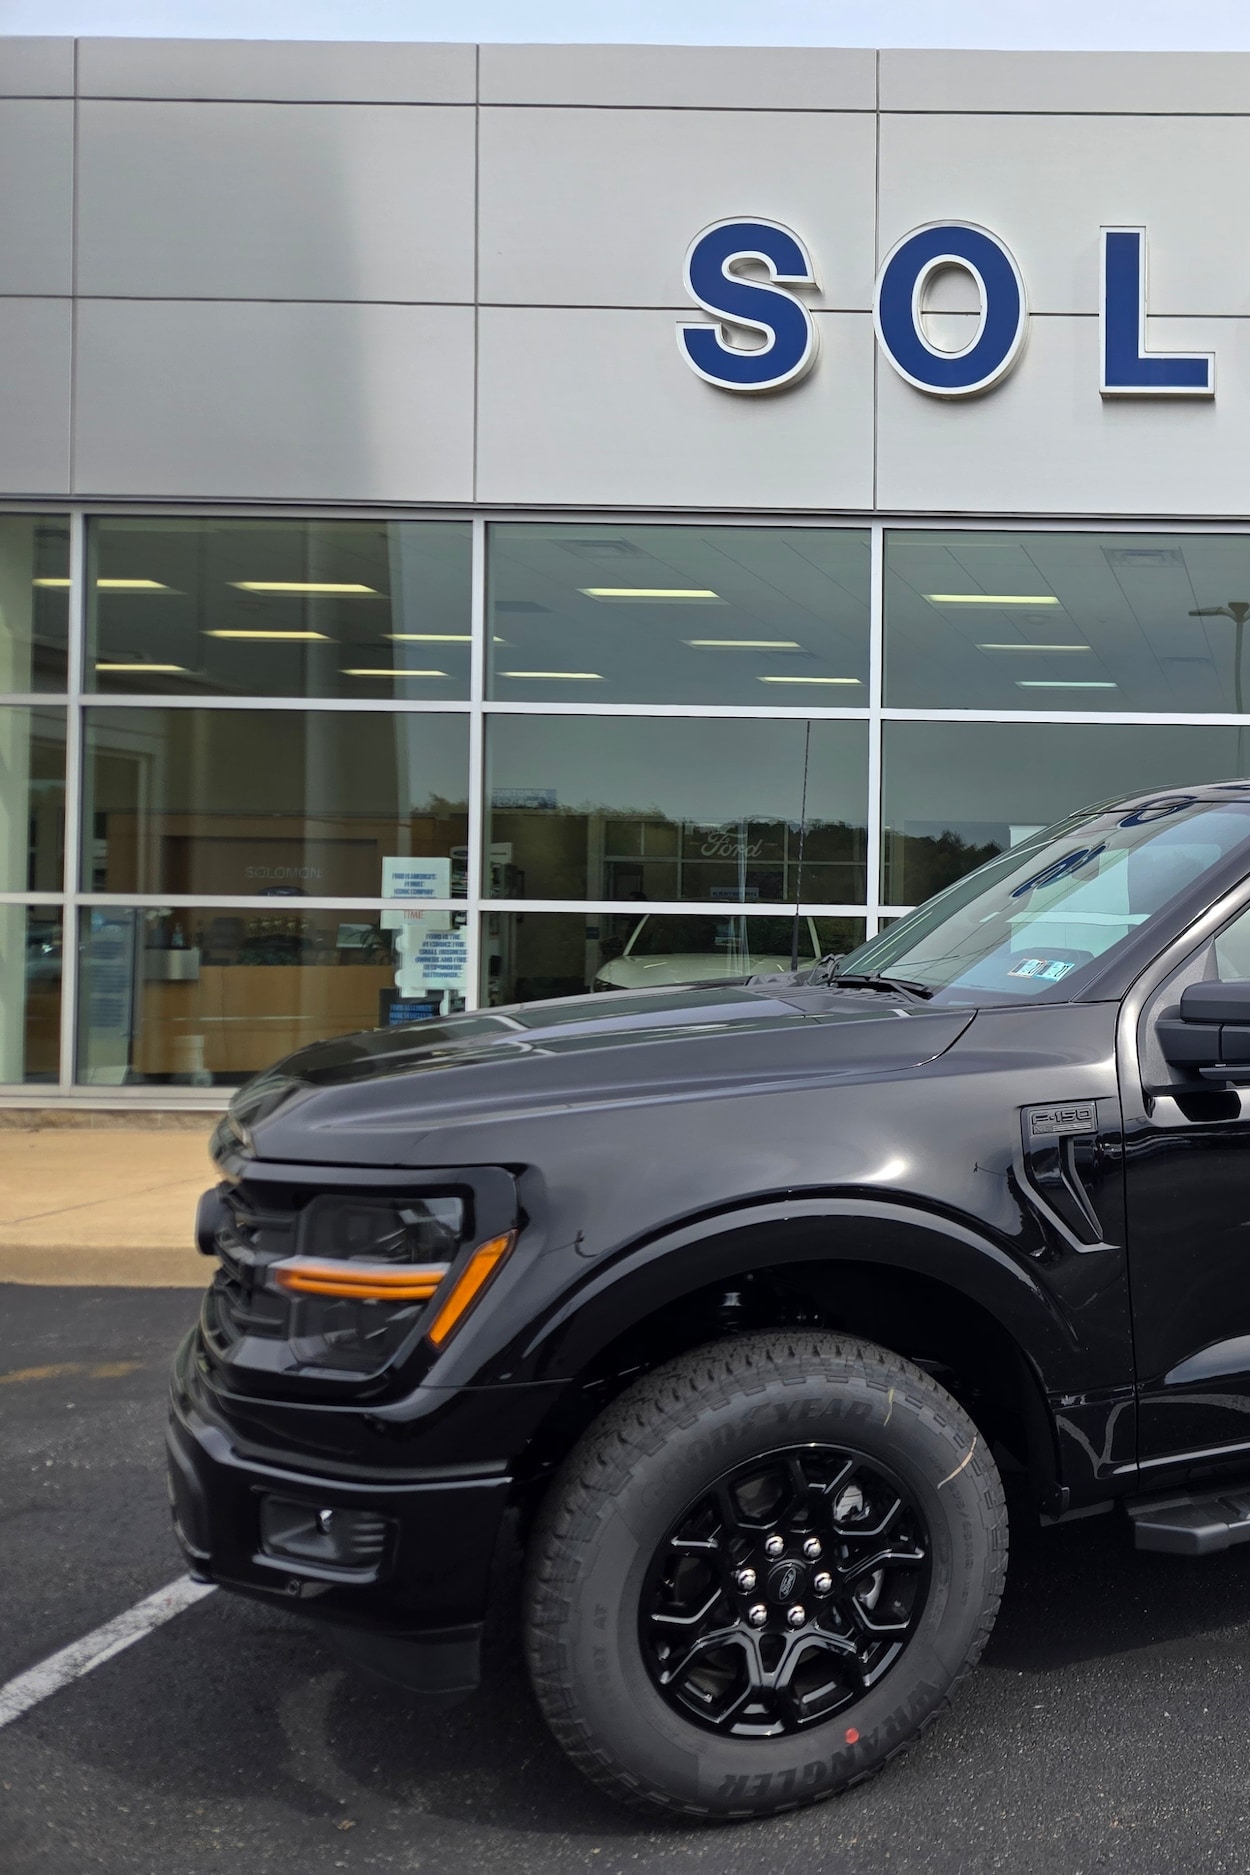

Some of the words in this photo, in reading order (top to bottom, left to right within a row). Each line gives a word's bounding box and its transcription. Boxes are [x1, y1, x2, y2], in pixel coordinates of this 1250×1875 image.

[700, 832, 764, 858] Ford
[244, 866, 324, 880] SOLOMON
[1031, 1108, 1093, 1125] F-150
[716, 1679, 941, 1799] WRANGLER
